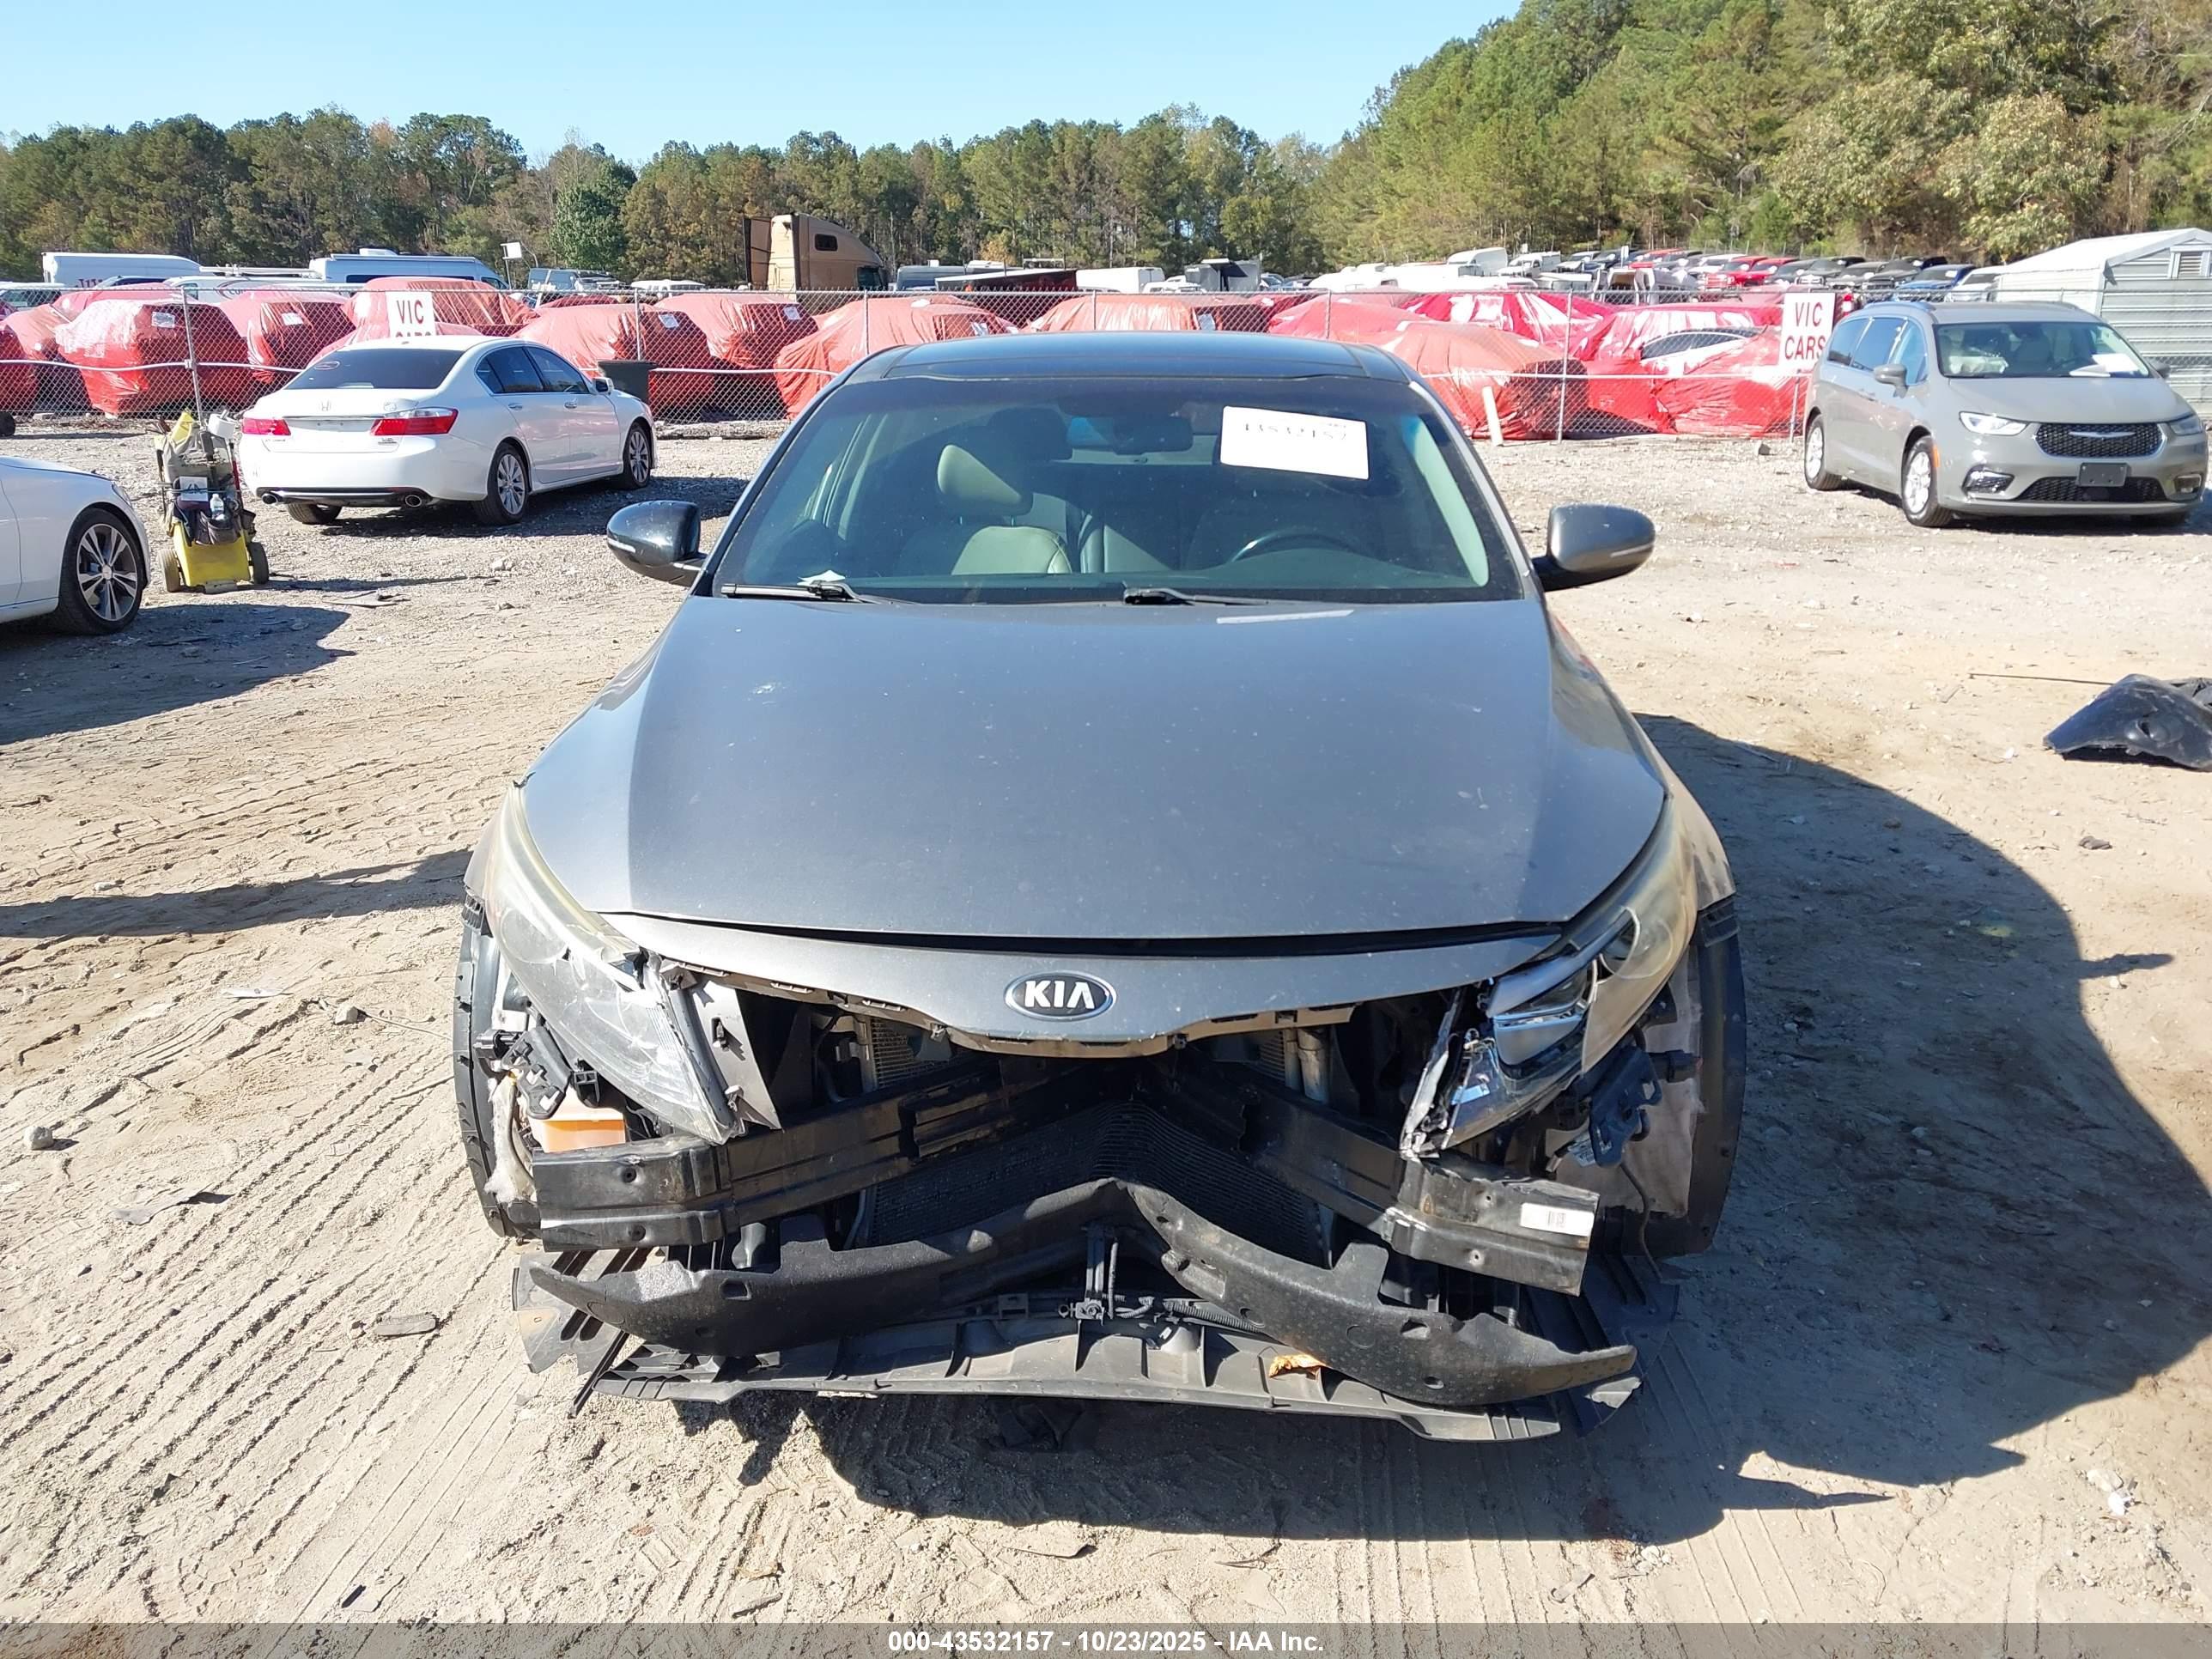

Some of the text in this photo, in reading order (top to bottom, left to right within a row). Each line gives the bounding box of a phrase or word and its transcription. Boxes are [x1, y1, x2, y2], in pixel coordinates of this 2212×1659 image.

[396, 299, 425, 325] VIC
[1795, 301, 1823, 327] VIC
[1784, 335, 1826, 361] CARS
[1024, 980, 1096, 1010] KIA
